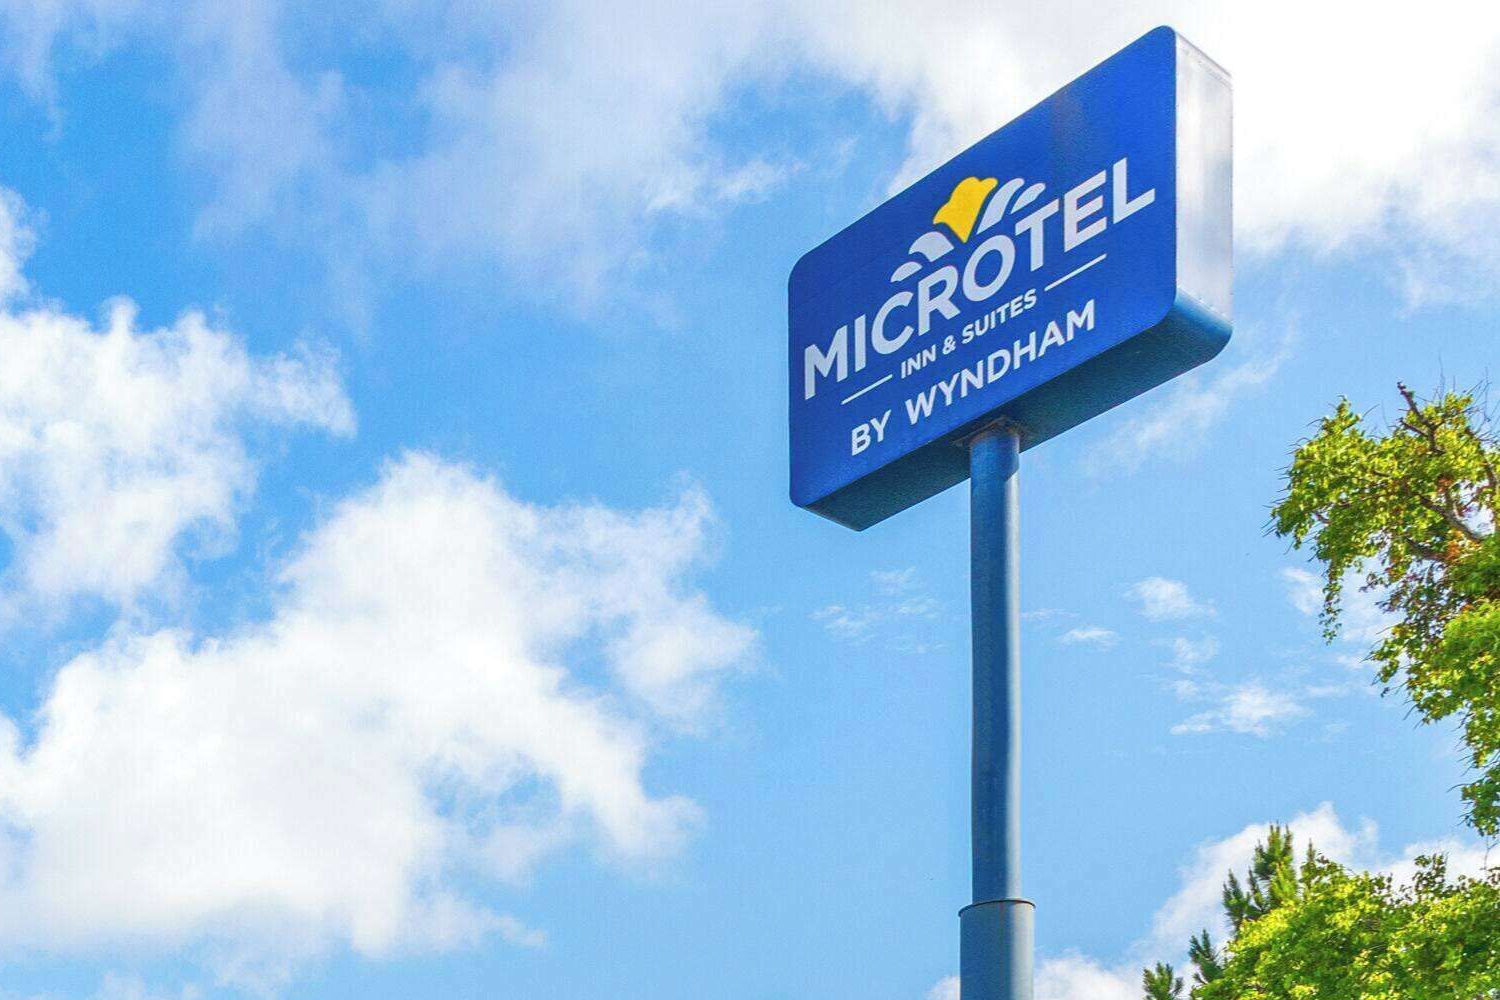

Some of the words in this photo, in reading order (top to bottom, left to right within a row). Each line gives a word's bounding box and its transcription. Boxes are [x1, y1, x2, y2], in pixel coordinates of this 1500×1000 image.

[804, 156, 1156, 401] MICROTEL
[901, 347, 936, 379] INN
[941, 334, 957, 355] &
[961, 289, 1037, 345] SUITES
[851, 409, 892, 456] BY
[904, 299, 1096, 425] WYNDHAM
